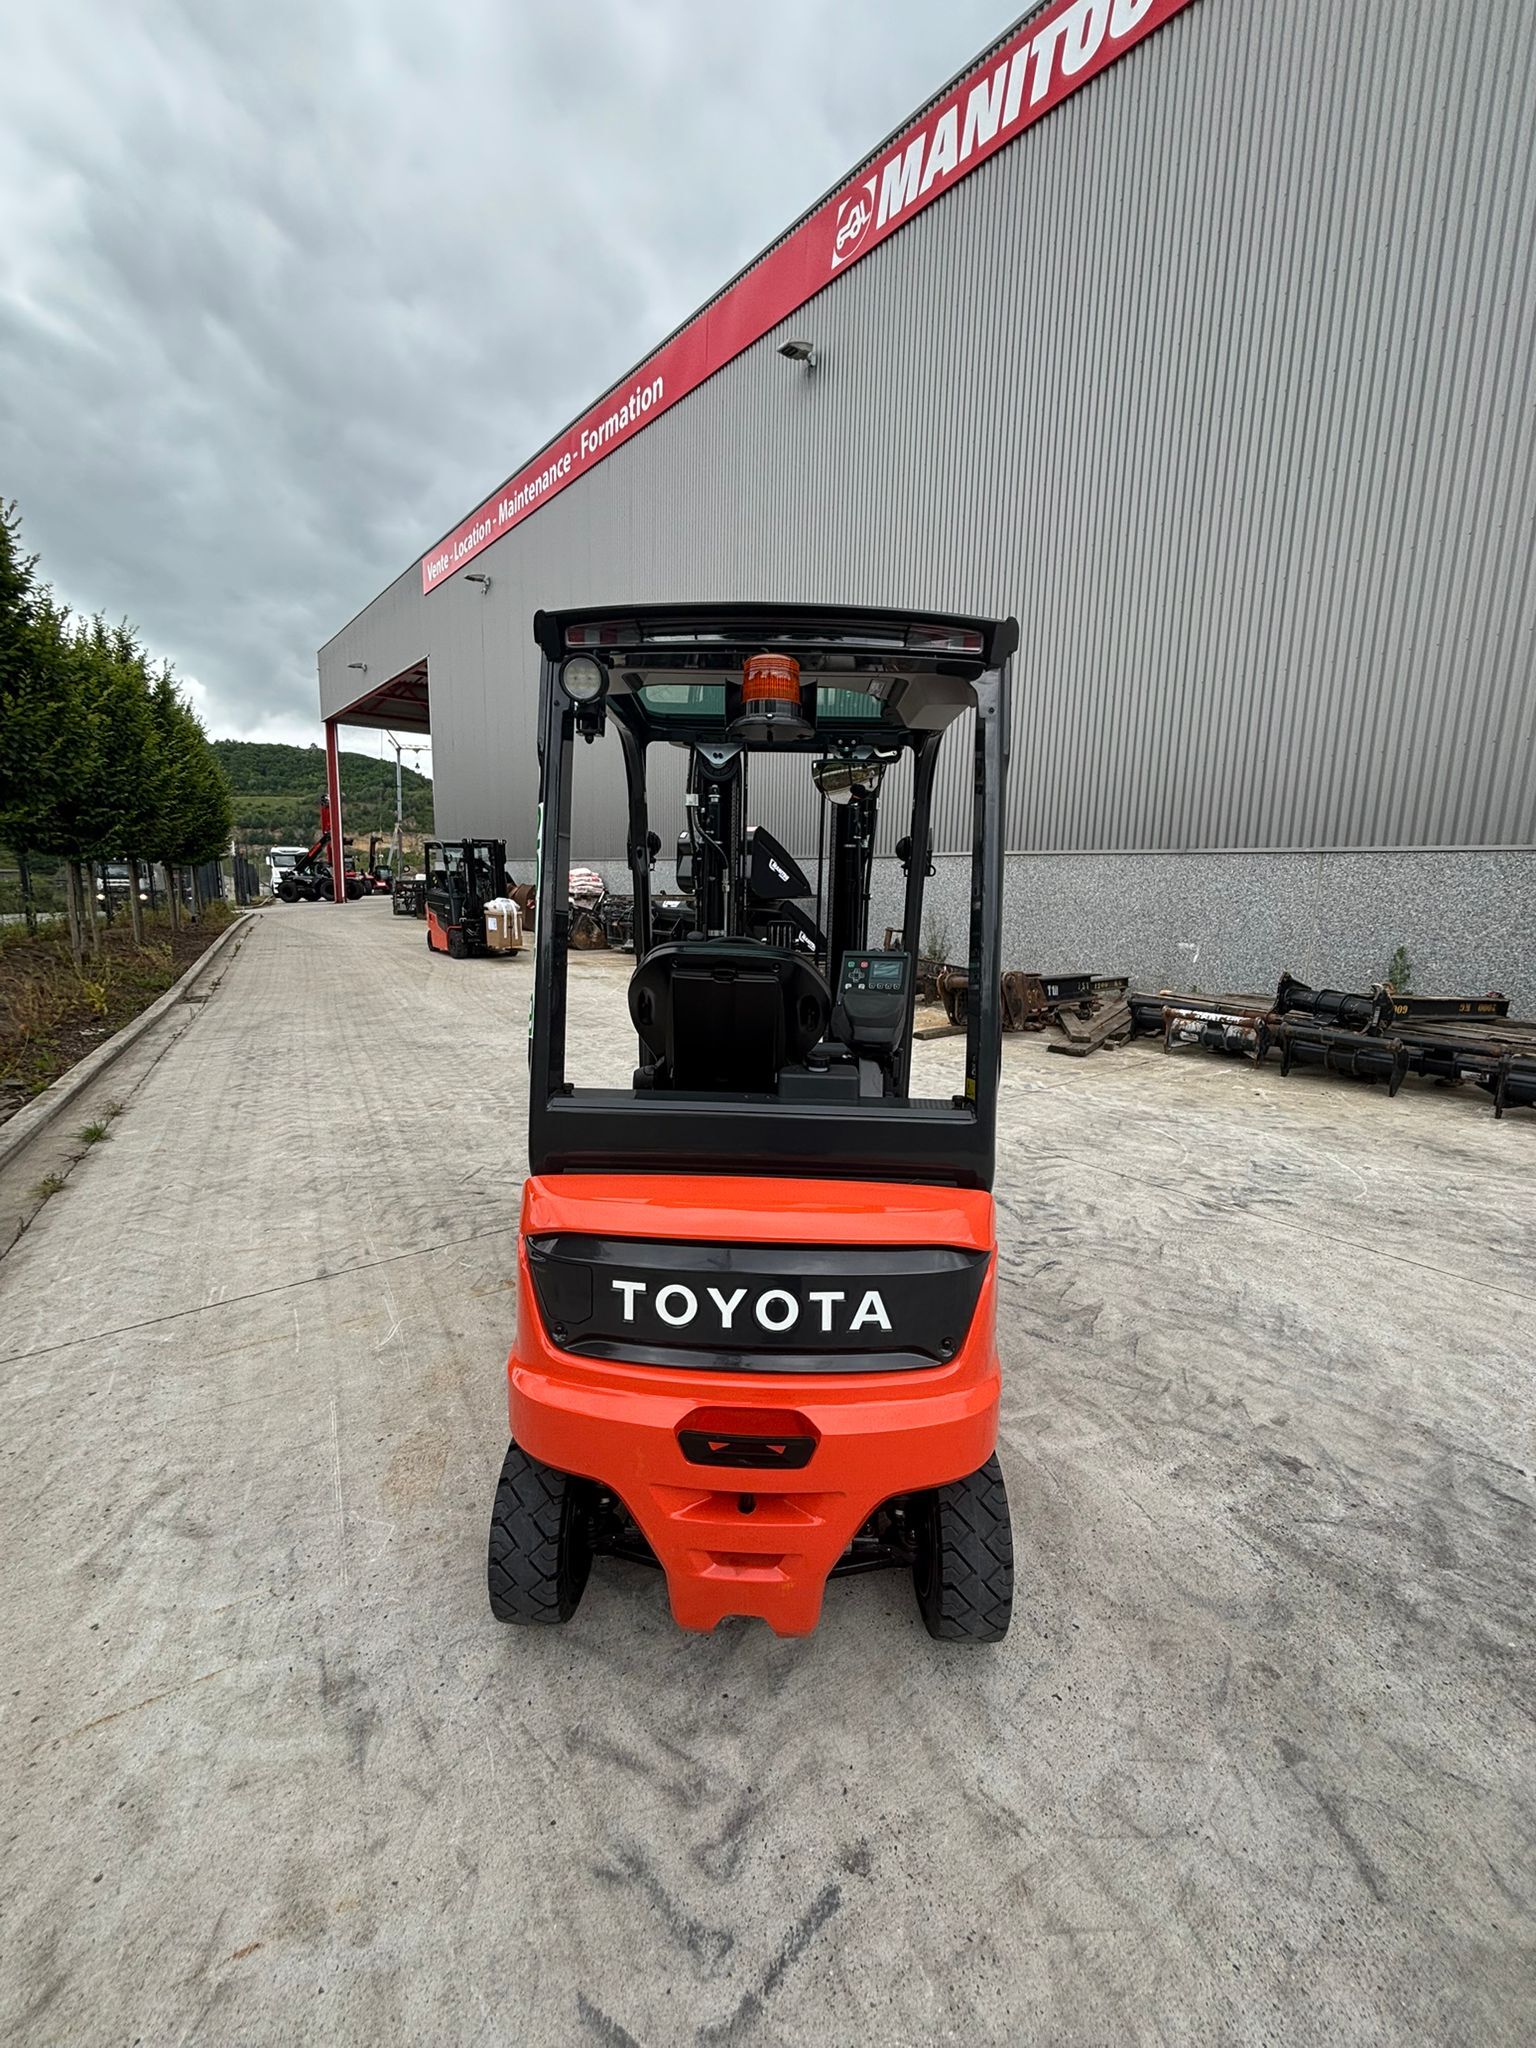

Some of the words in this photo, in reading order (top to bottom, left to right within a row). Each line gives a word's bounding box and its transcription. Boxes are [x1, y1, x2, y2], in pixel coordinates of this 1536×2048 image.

[427, 553, 449, 582] Vente
[454, 518, 491, 561] Location
[498, 452, 571, 526] Maintenance
[581, 376, 664, 460] Formation
[612, 1280, 893, 1332] TOYOTA
